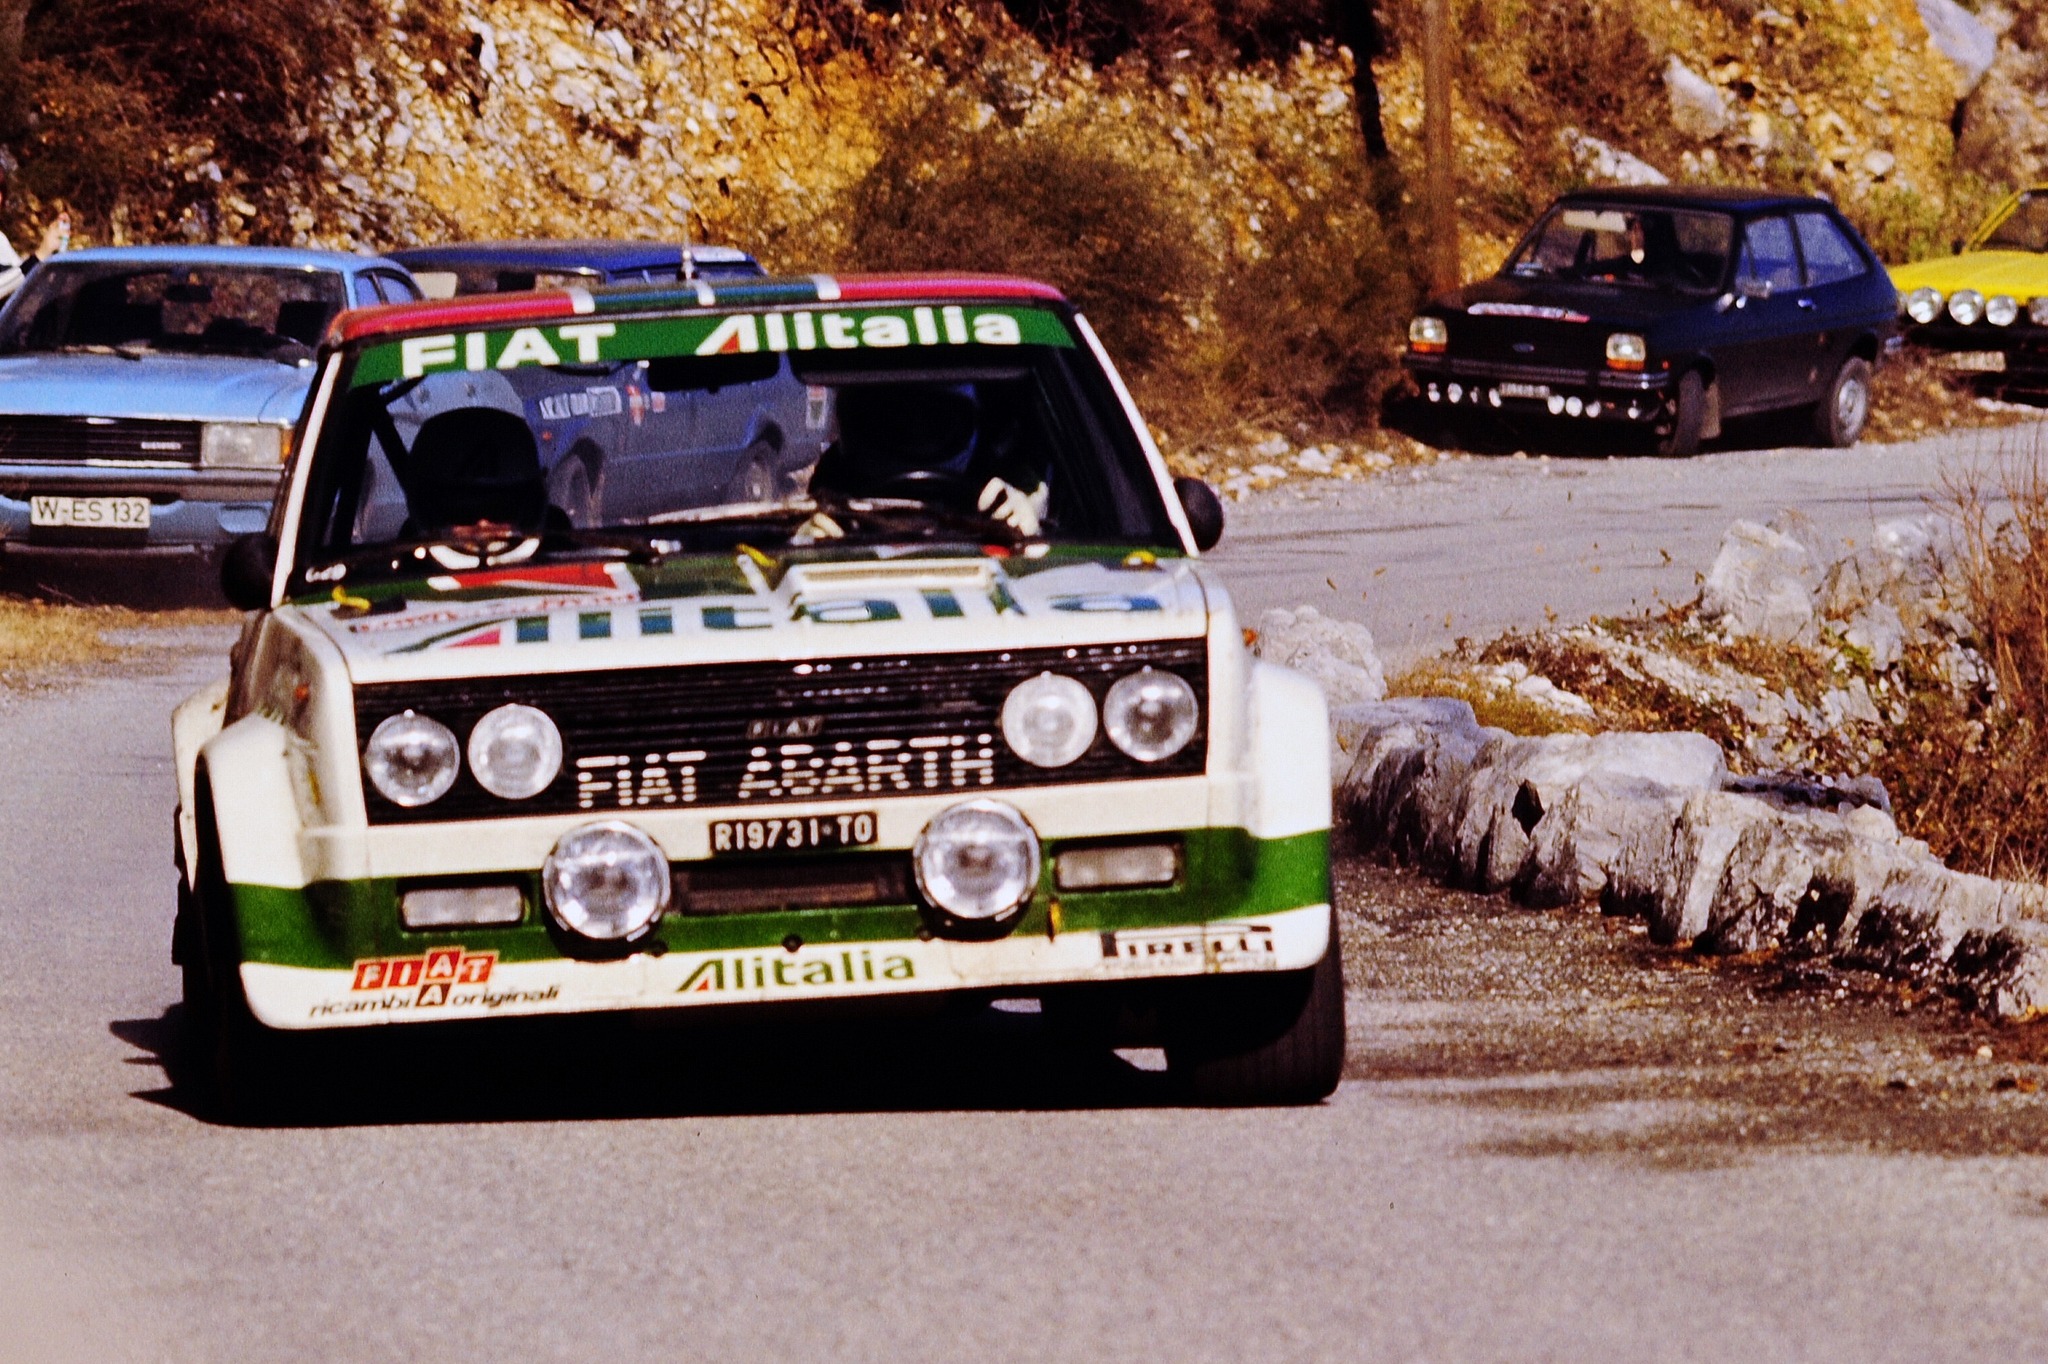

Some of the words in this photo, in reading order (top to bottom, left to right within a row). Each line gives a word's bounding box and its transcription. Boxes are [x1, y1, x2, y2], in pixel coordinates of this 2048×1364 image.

[402, 323, 616, 378] FIAT
[695, 306, 1021, 356] Alitalia
[112, 501, 145, 523] 132
[386, 584, 1162, 654] Alitalia
[577, 750, 706, 808] FIAT
[738, 733, 992, 799] ABARTH
[356, 949, 490, 989] FIAT
[676, 950, 915, 993] Alitalia
[310, 990, 410, 1018] ricambi
[453, 984, 561, 1008] originali
